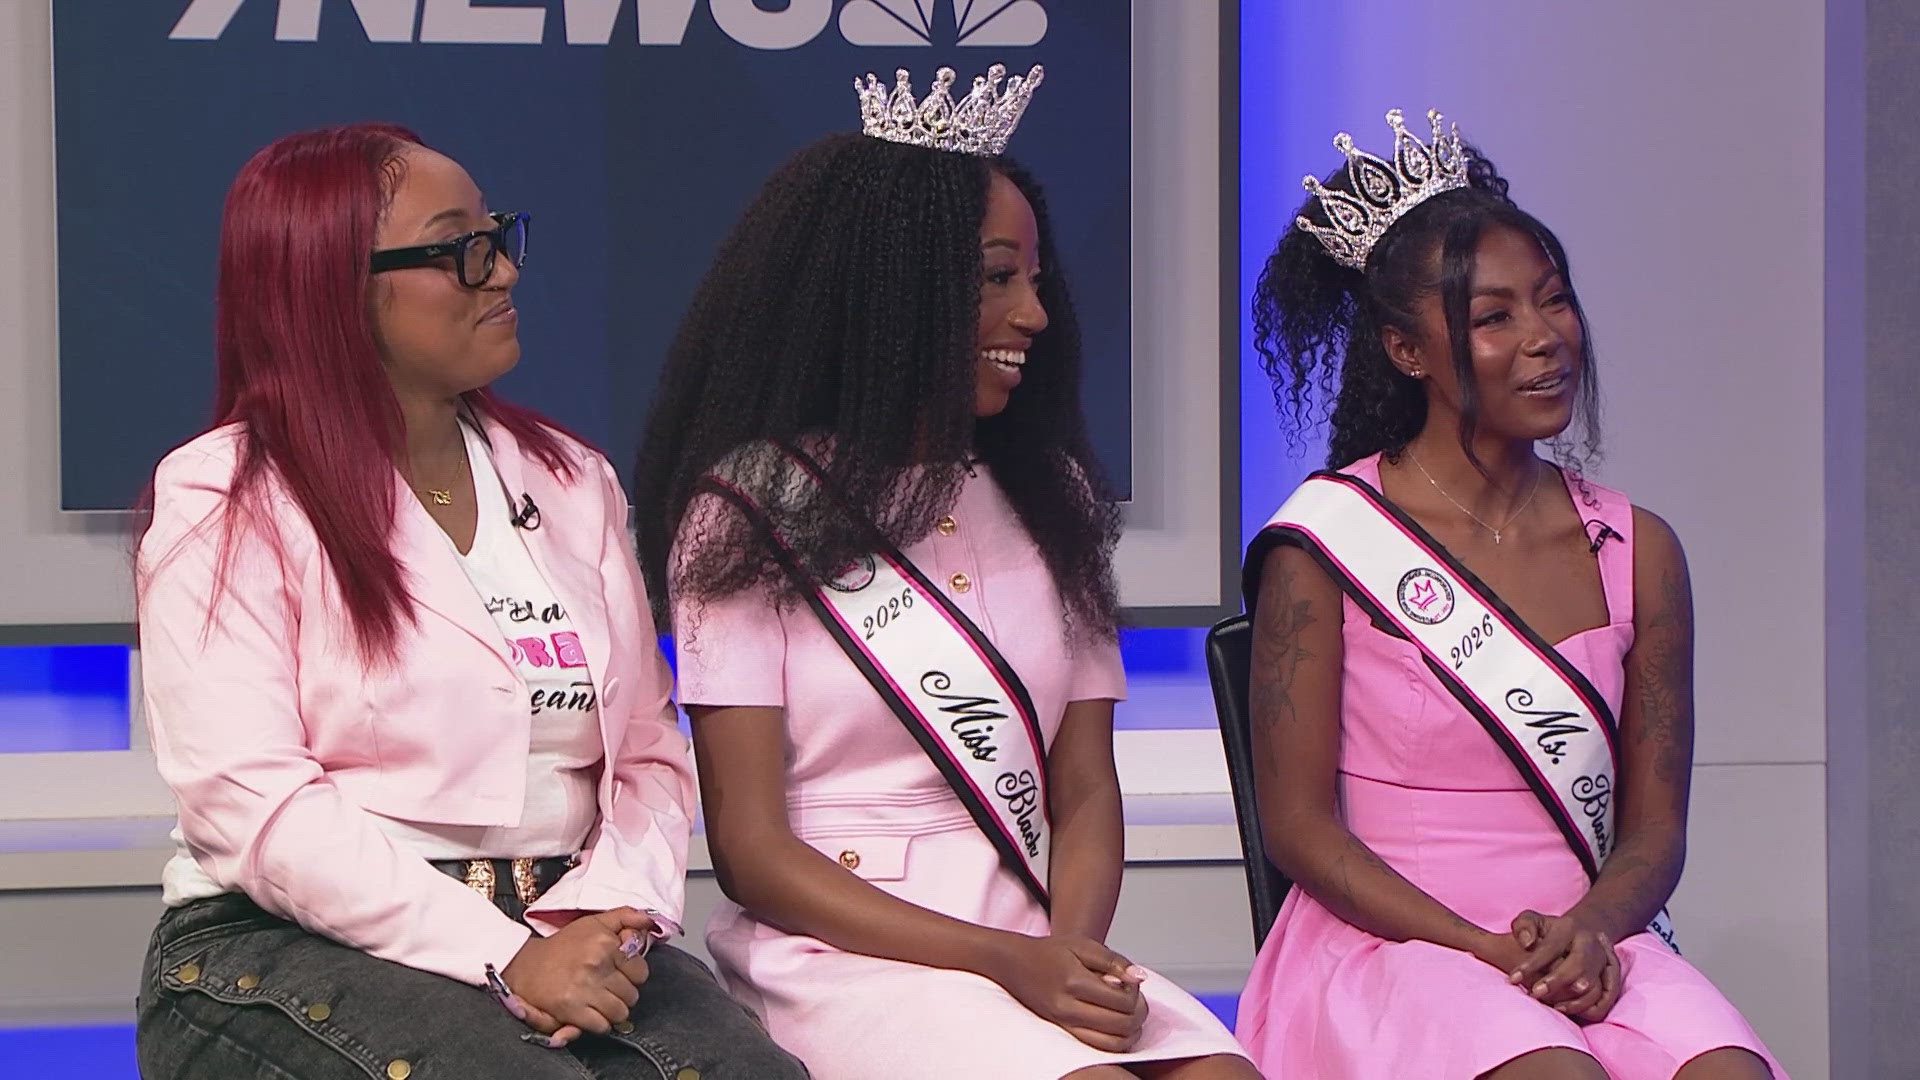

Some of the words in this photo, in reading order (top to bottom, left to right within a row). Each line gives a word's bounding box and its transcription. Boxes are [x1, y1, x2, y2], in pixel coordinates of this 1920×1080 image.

[863, 587, 914, 641] 2026
[1450, 613, 1494, 670] 2026
[1505, 688, 1589, 765] Ms.
[920, 670, 1009, 763] Miss
[995, 769, 1041, 858] Black
